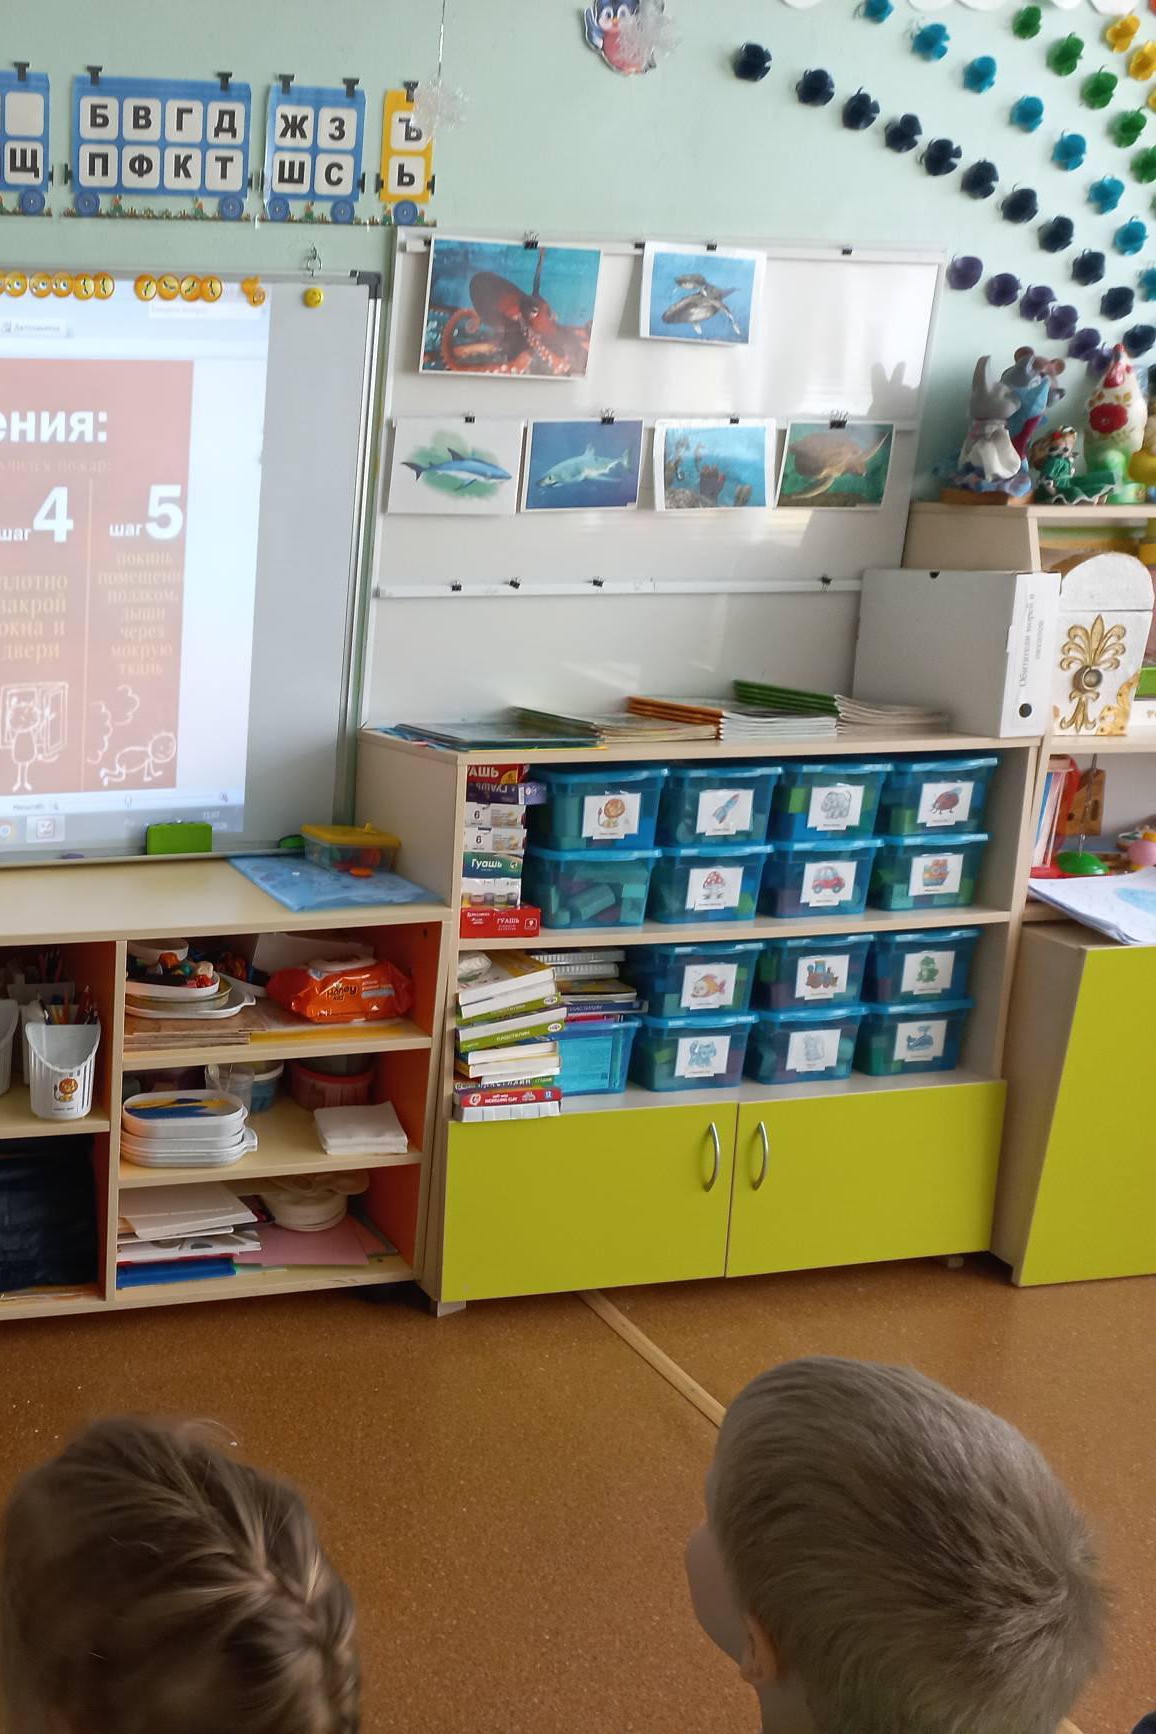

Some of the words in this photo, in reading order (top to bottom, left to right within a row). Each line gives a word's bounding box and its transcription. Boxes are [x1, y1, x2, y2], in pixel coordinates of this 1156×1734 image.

[33, 486, 74, 543] 4
[109, 522, 143, 537] шаг
[145, 484, 184, 540] 5
[54, 621, 66, 636] и
[1, 643, 61, 664] двери
[474, 810, 481, 820] 6
[476, 836, 482, 845] 6
[471, 858, 503, 873] Гуашь
[326, 986, 357, 997] Honey
